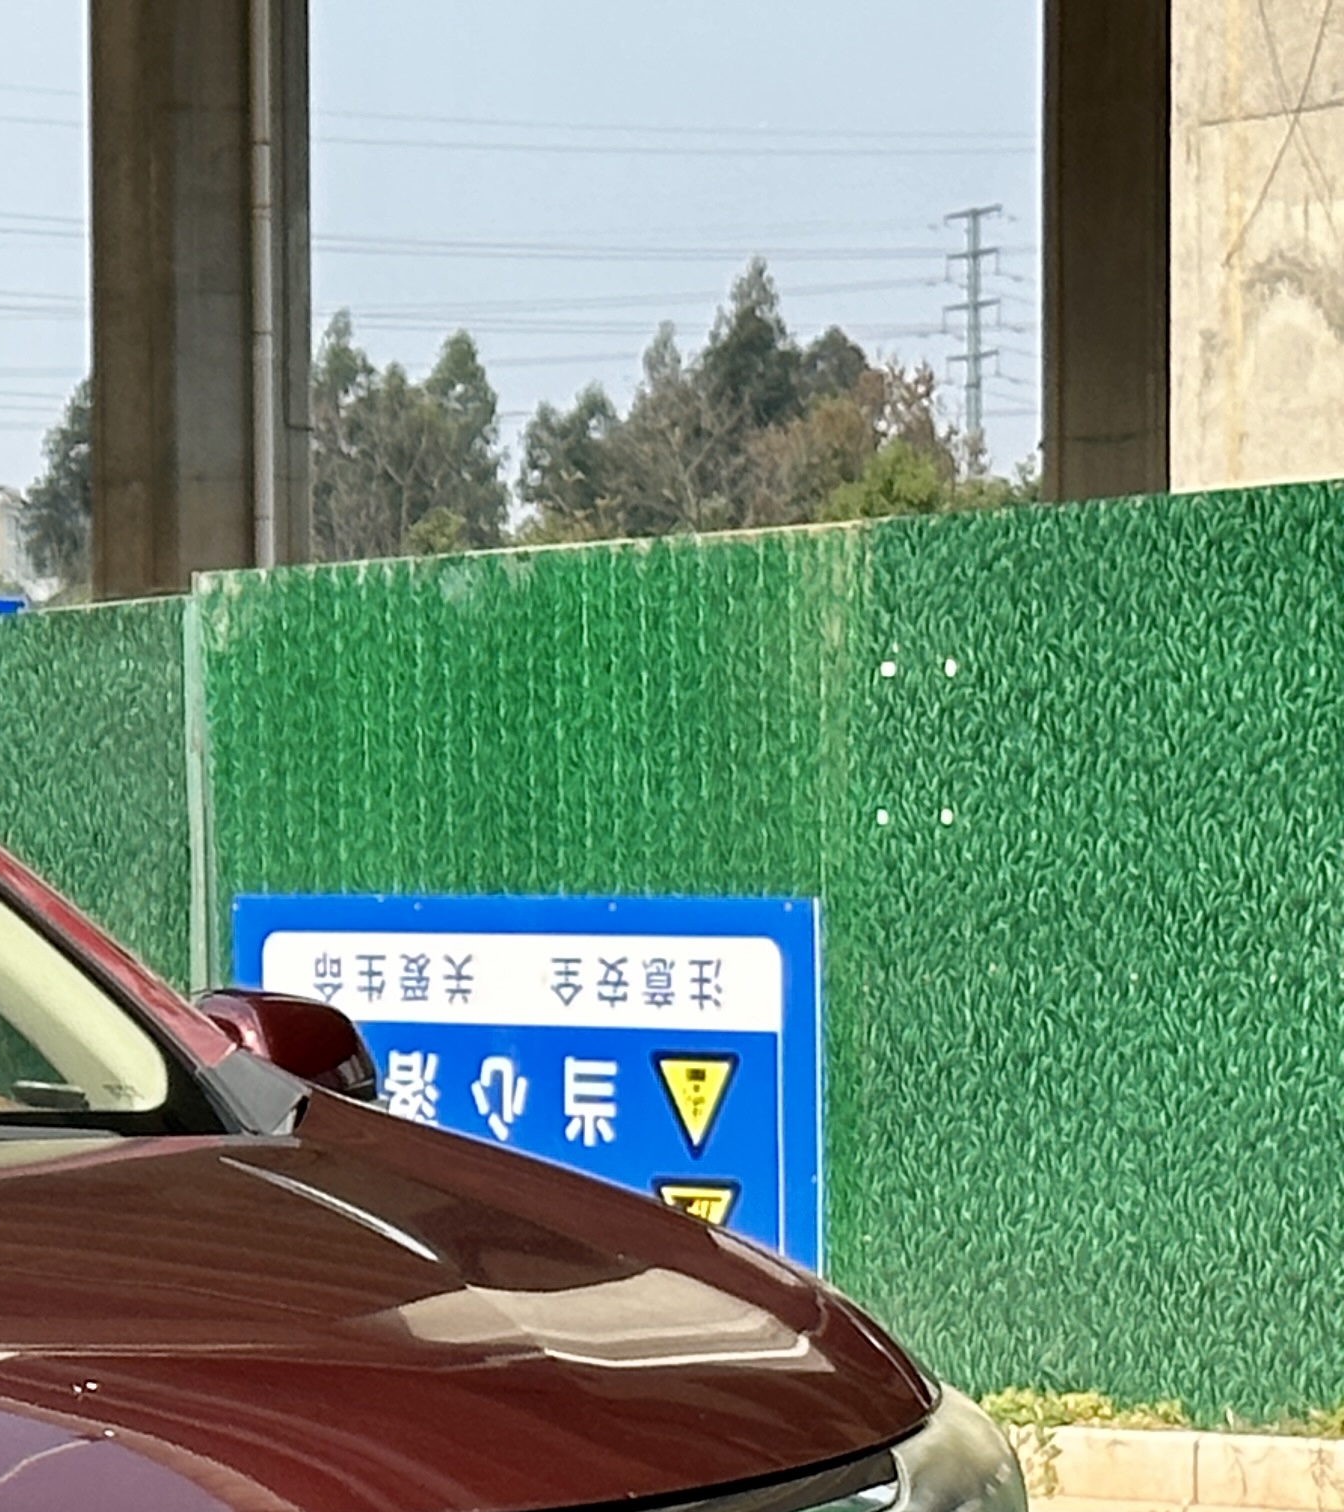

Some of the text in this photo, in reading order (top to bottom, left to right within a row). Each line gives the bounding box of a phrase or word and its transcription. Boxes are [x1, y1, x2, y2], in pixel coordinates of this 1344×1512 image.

[313, 952, 723, 1009] 注意安全 关爱生命
